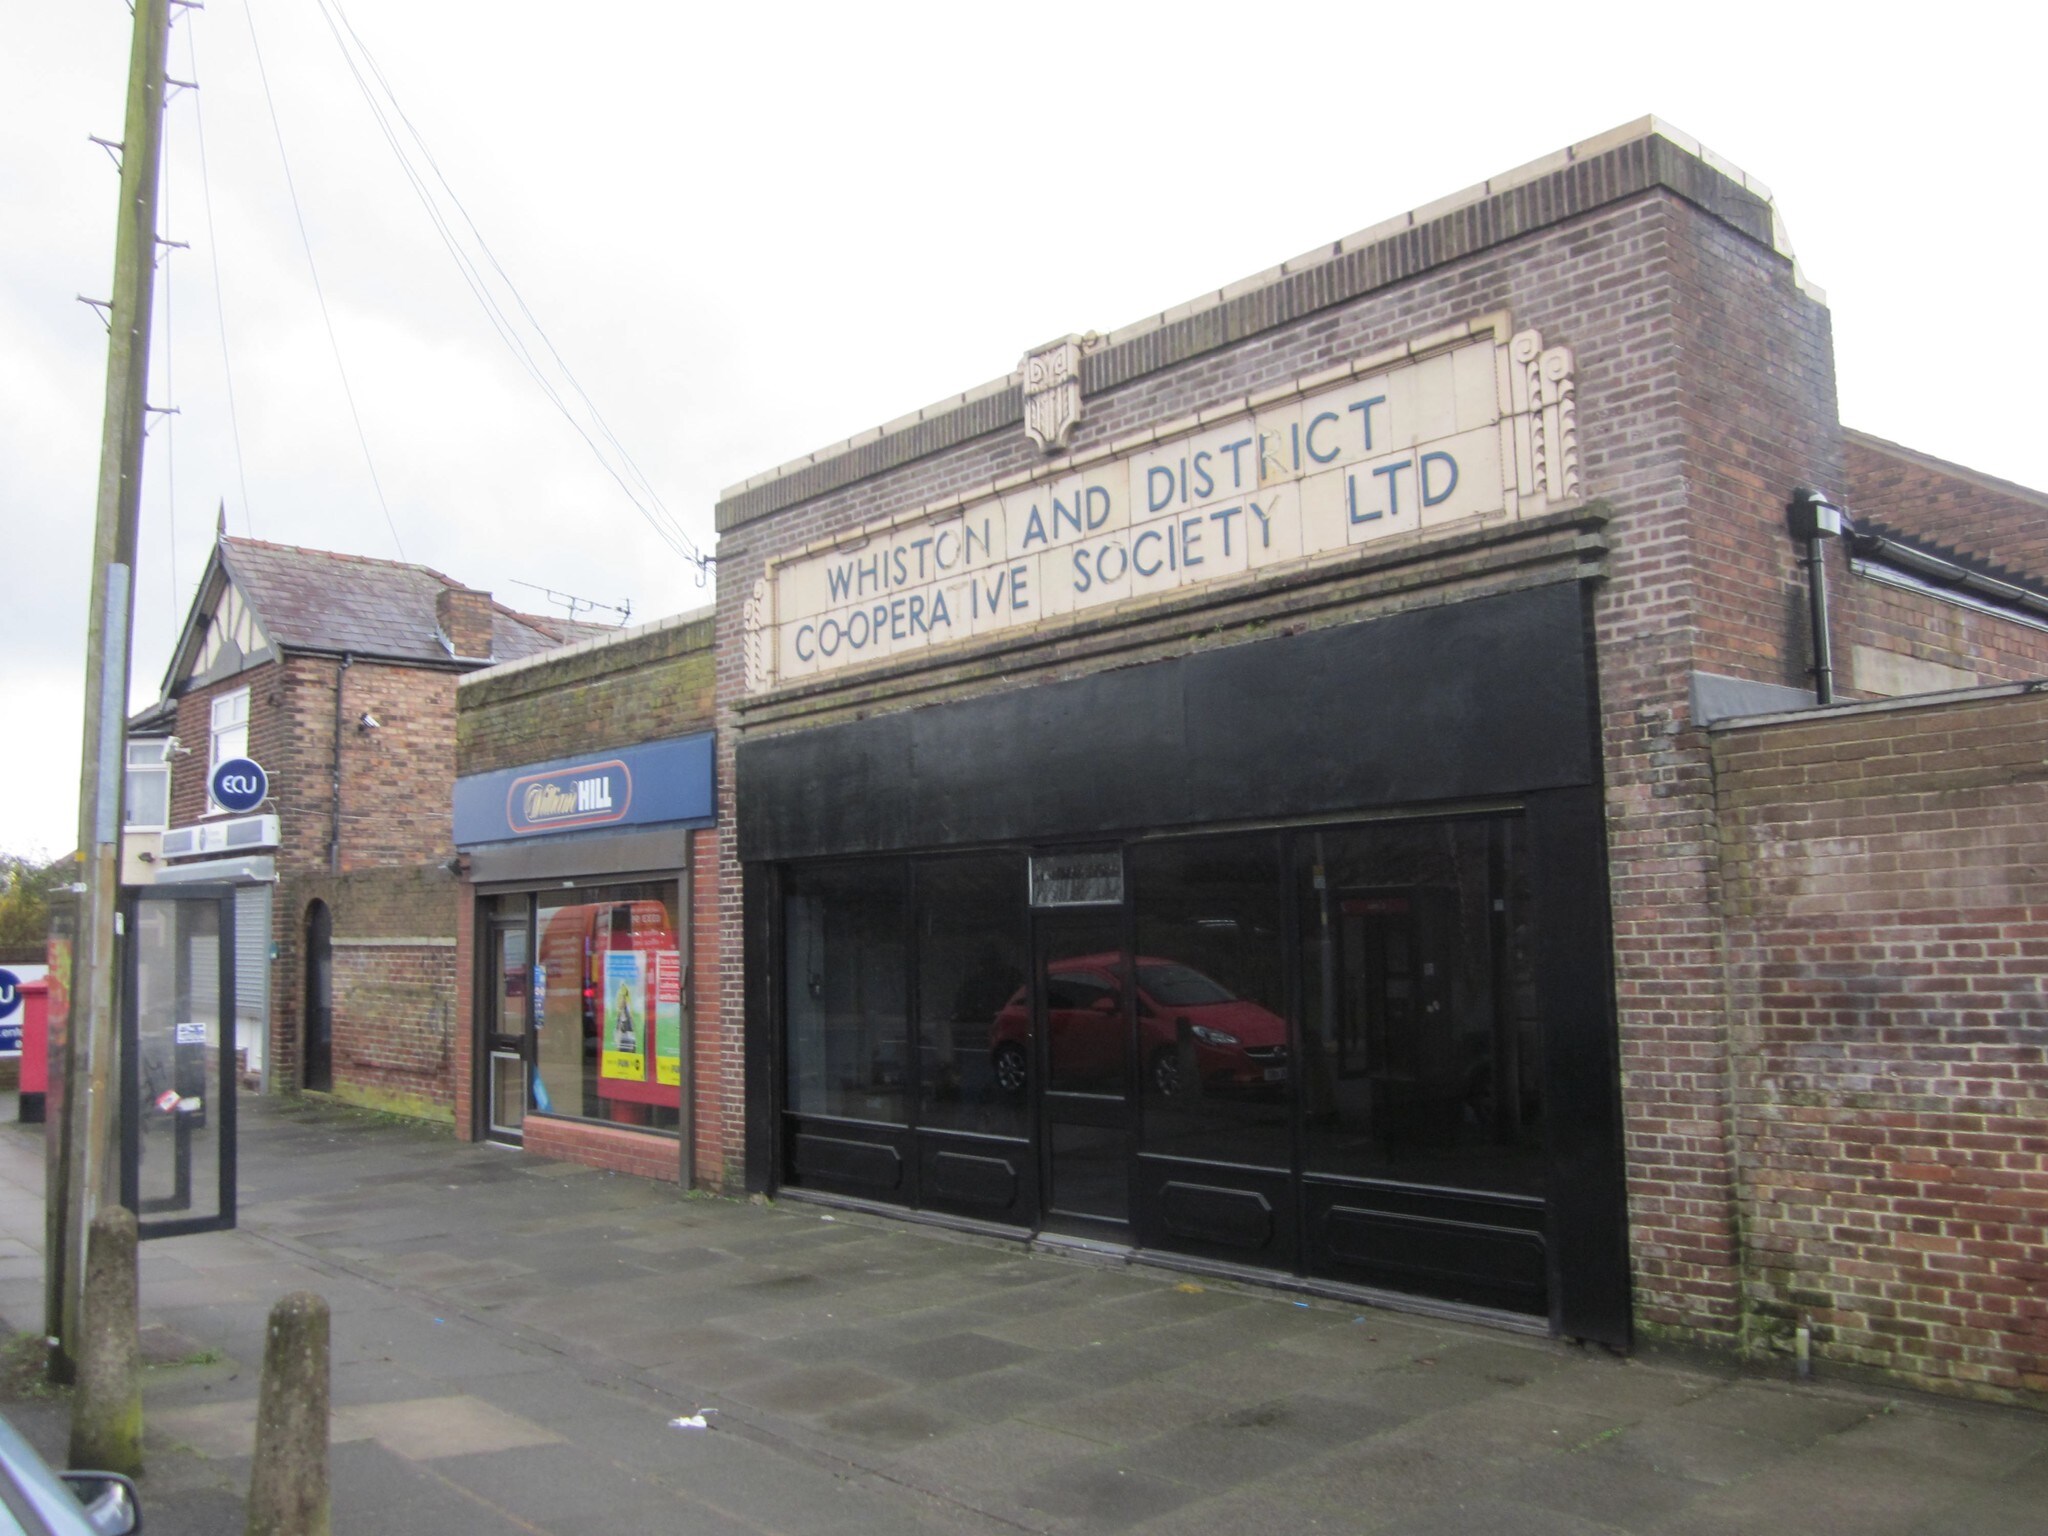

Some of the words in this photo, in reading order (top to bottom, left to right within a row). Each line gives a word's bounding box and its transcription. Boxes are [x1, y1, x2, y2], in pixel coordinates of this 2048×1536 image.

[795, 565, 1029, 662] CO-OPERATIVE
[1073, 495, 1281, 593] SOCIETY
[1348, 450, 1459, 525] LTD
[828, 519, 991, 603] WHISTON
[1022, 485, 1111, 549] AND
[1147, 394, 1386, 512] DISTRICT
[578, 776, 612, 811] HILL
